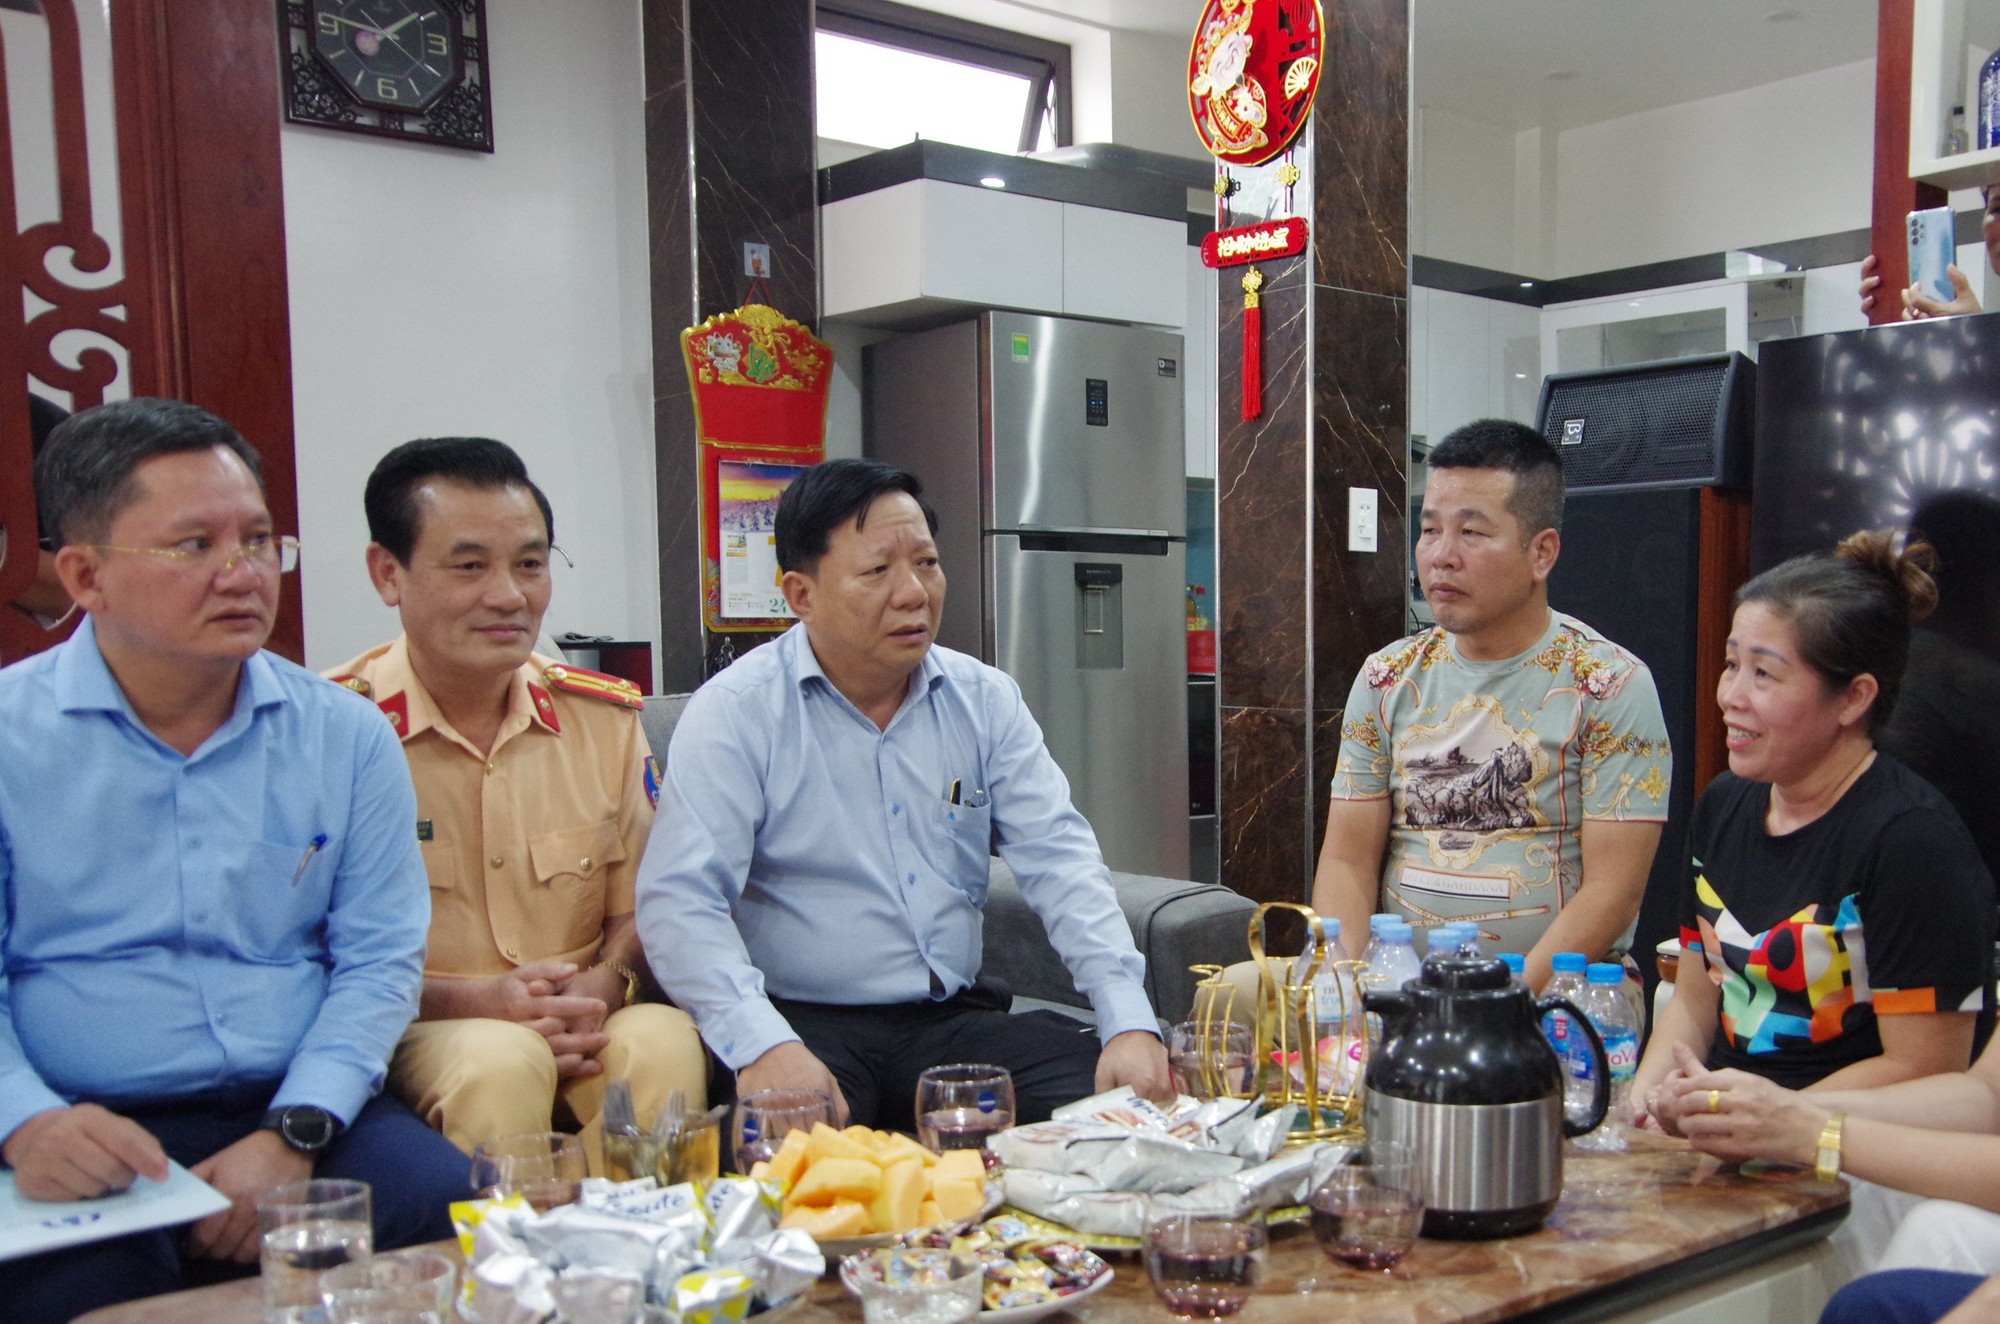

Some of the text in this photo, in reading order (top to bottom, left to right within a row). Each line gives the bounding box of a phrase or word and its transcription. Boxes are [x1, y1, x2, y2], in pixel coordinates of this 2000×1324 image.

[318, 12, 339, 36] 9
[427, 33, 447, 56] 3
[377, 78, 398, 100] 6
